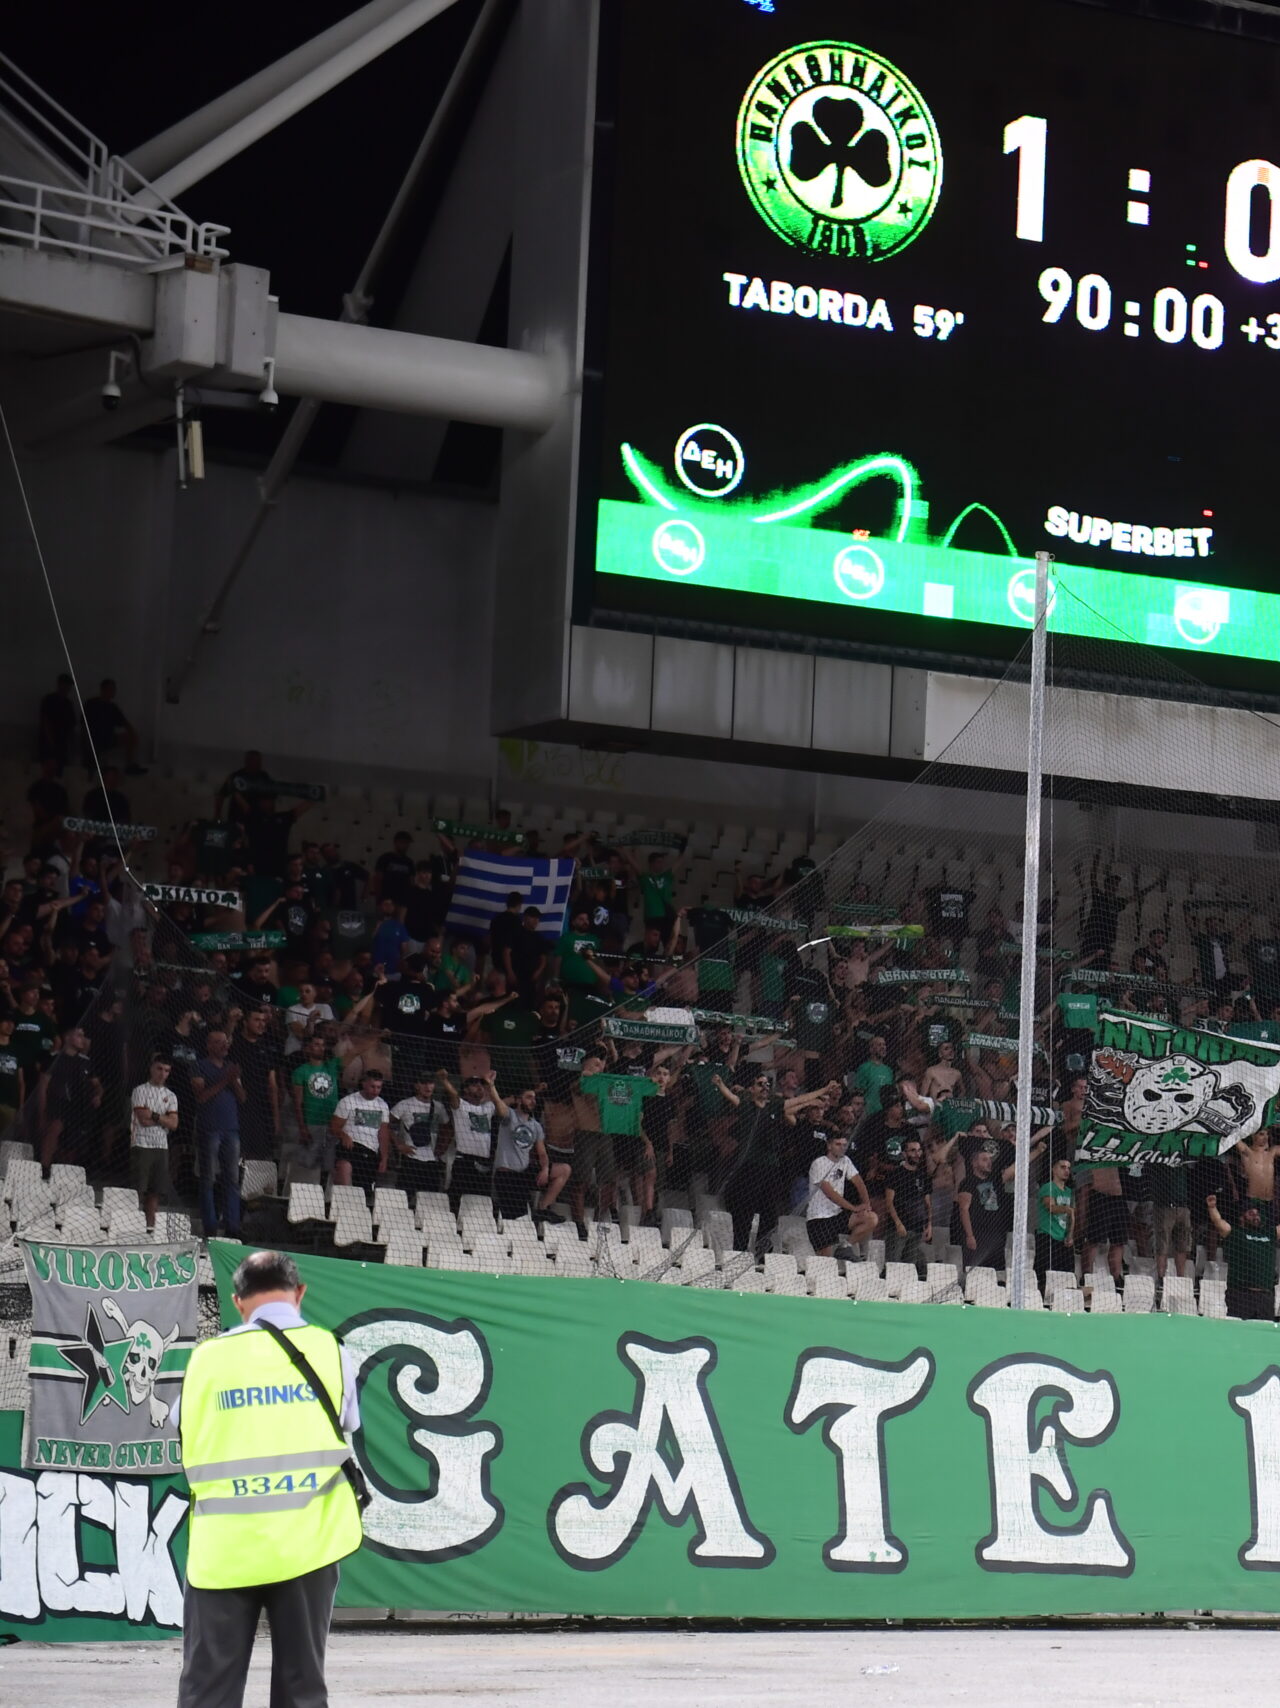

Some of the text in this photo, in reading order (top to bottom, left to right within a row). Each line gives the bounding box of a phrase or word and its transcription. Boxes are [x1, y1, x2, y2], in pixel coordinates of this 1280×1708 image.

[1003, 115, 1047, 242] 1
[723, 272, 964, 341] TABORDA 59'
[1038, 267, 1224, 350] 90:00
[1044, 506, 1213, 558] SUPERBET
[162, 886, 219, 905] KIATO
[27, 1243, 197, 1293] VIRONAS
[35, 1438, 112, 1469] NEVER
[114, 1440, 165, 1469] GIVE
[335, 1308, 1136, 1579] GATE
[232, 1472, 319, 1497] B344
